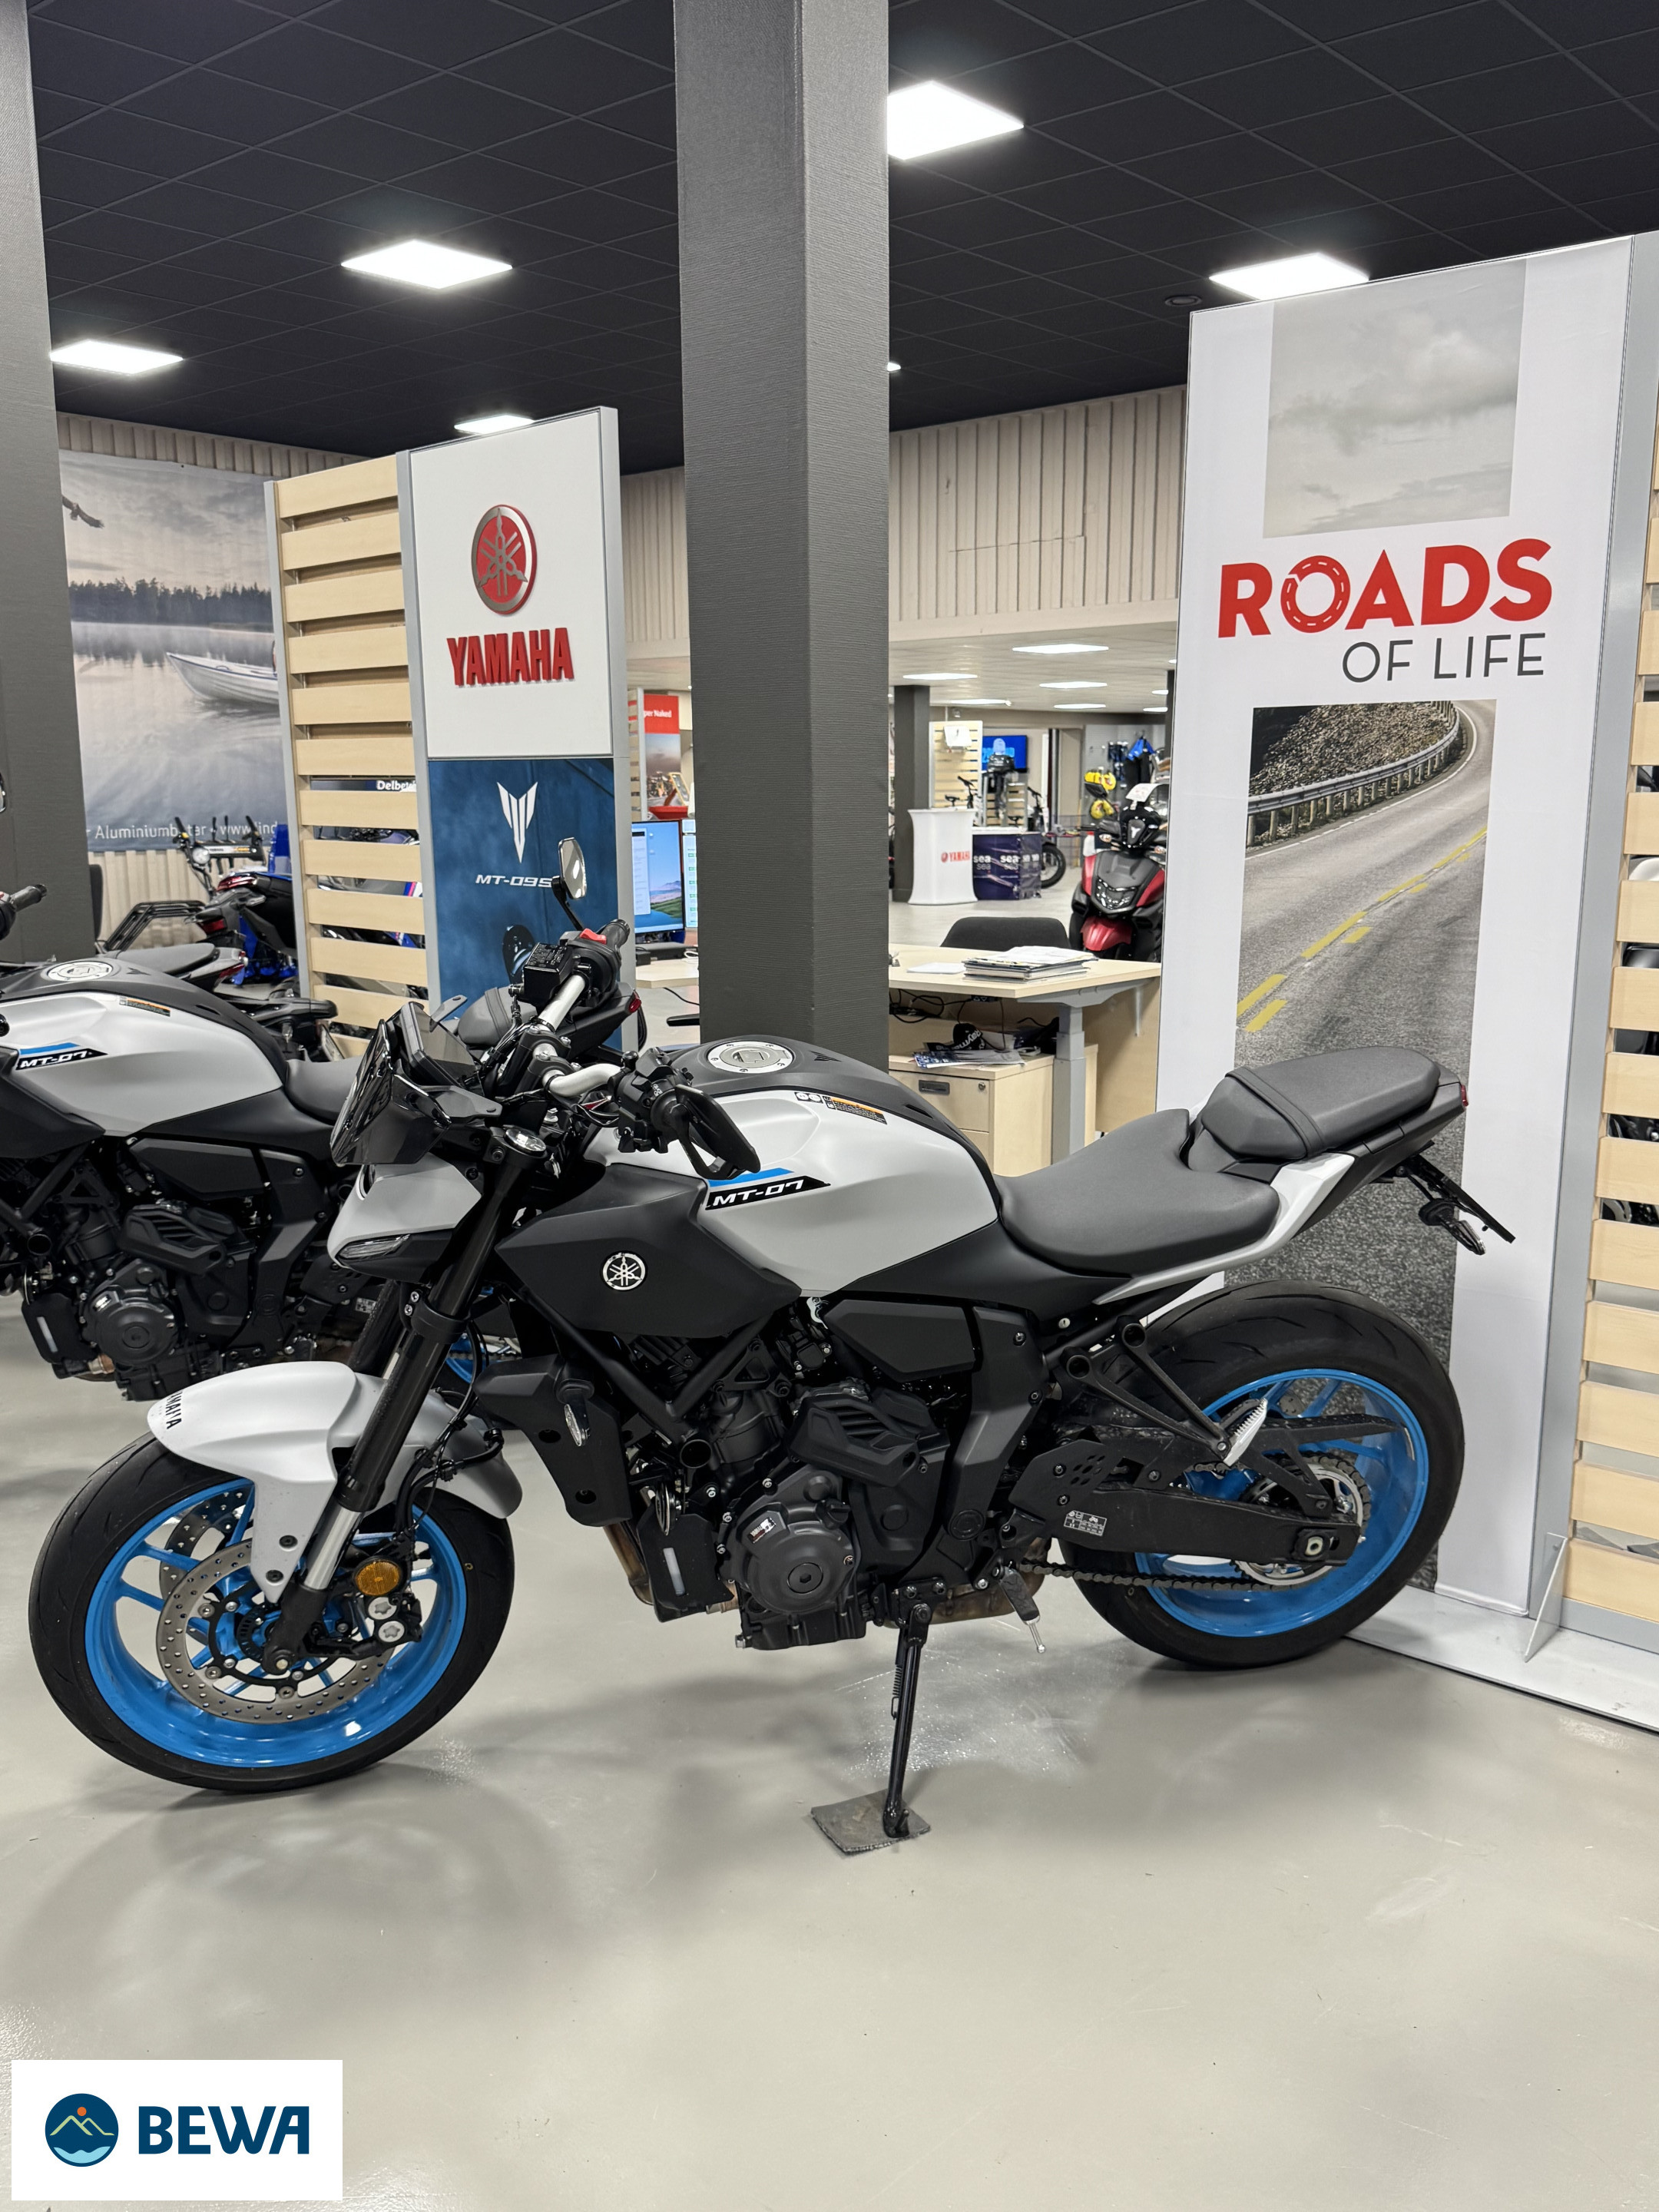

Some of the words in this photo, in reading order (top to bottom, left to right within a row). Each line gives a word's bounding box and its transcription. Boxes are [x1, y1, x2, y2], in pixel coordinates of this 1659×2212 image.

[1218, 538, 1552, 638] ROADS
[446, 628, 575, 686] YAMAHA
[1343, 639, 1414, 683] OF
[1434, 633, 1546, 679] LIFE
[95, 823, 206, 839] Aluminiumbter
[974, 855, 992, 863] sea
[1000, 855, 1019, 863] sea
[20, 1050, 88, 1068] MT-07
[713, 1179, 803, 1207] MT-07
